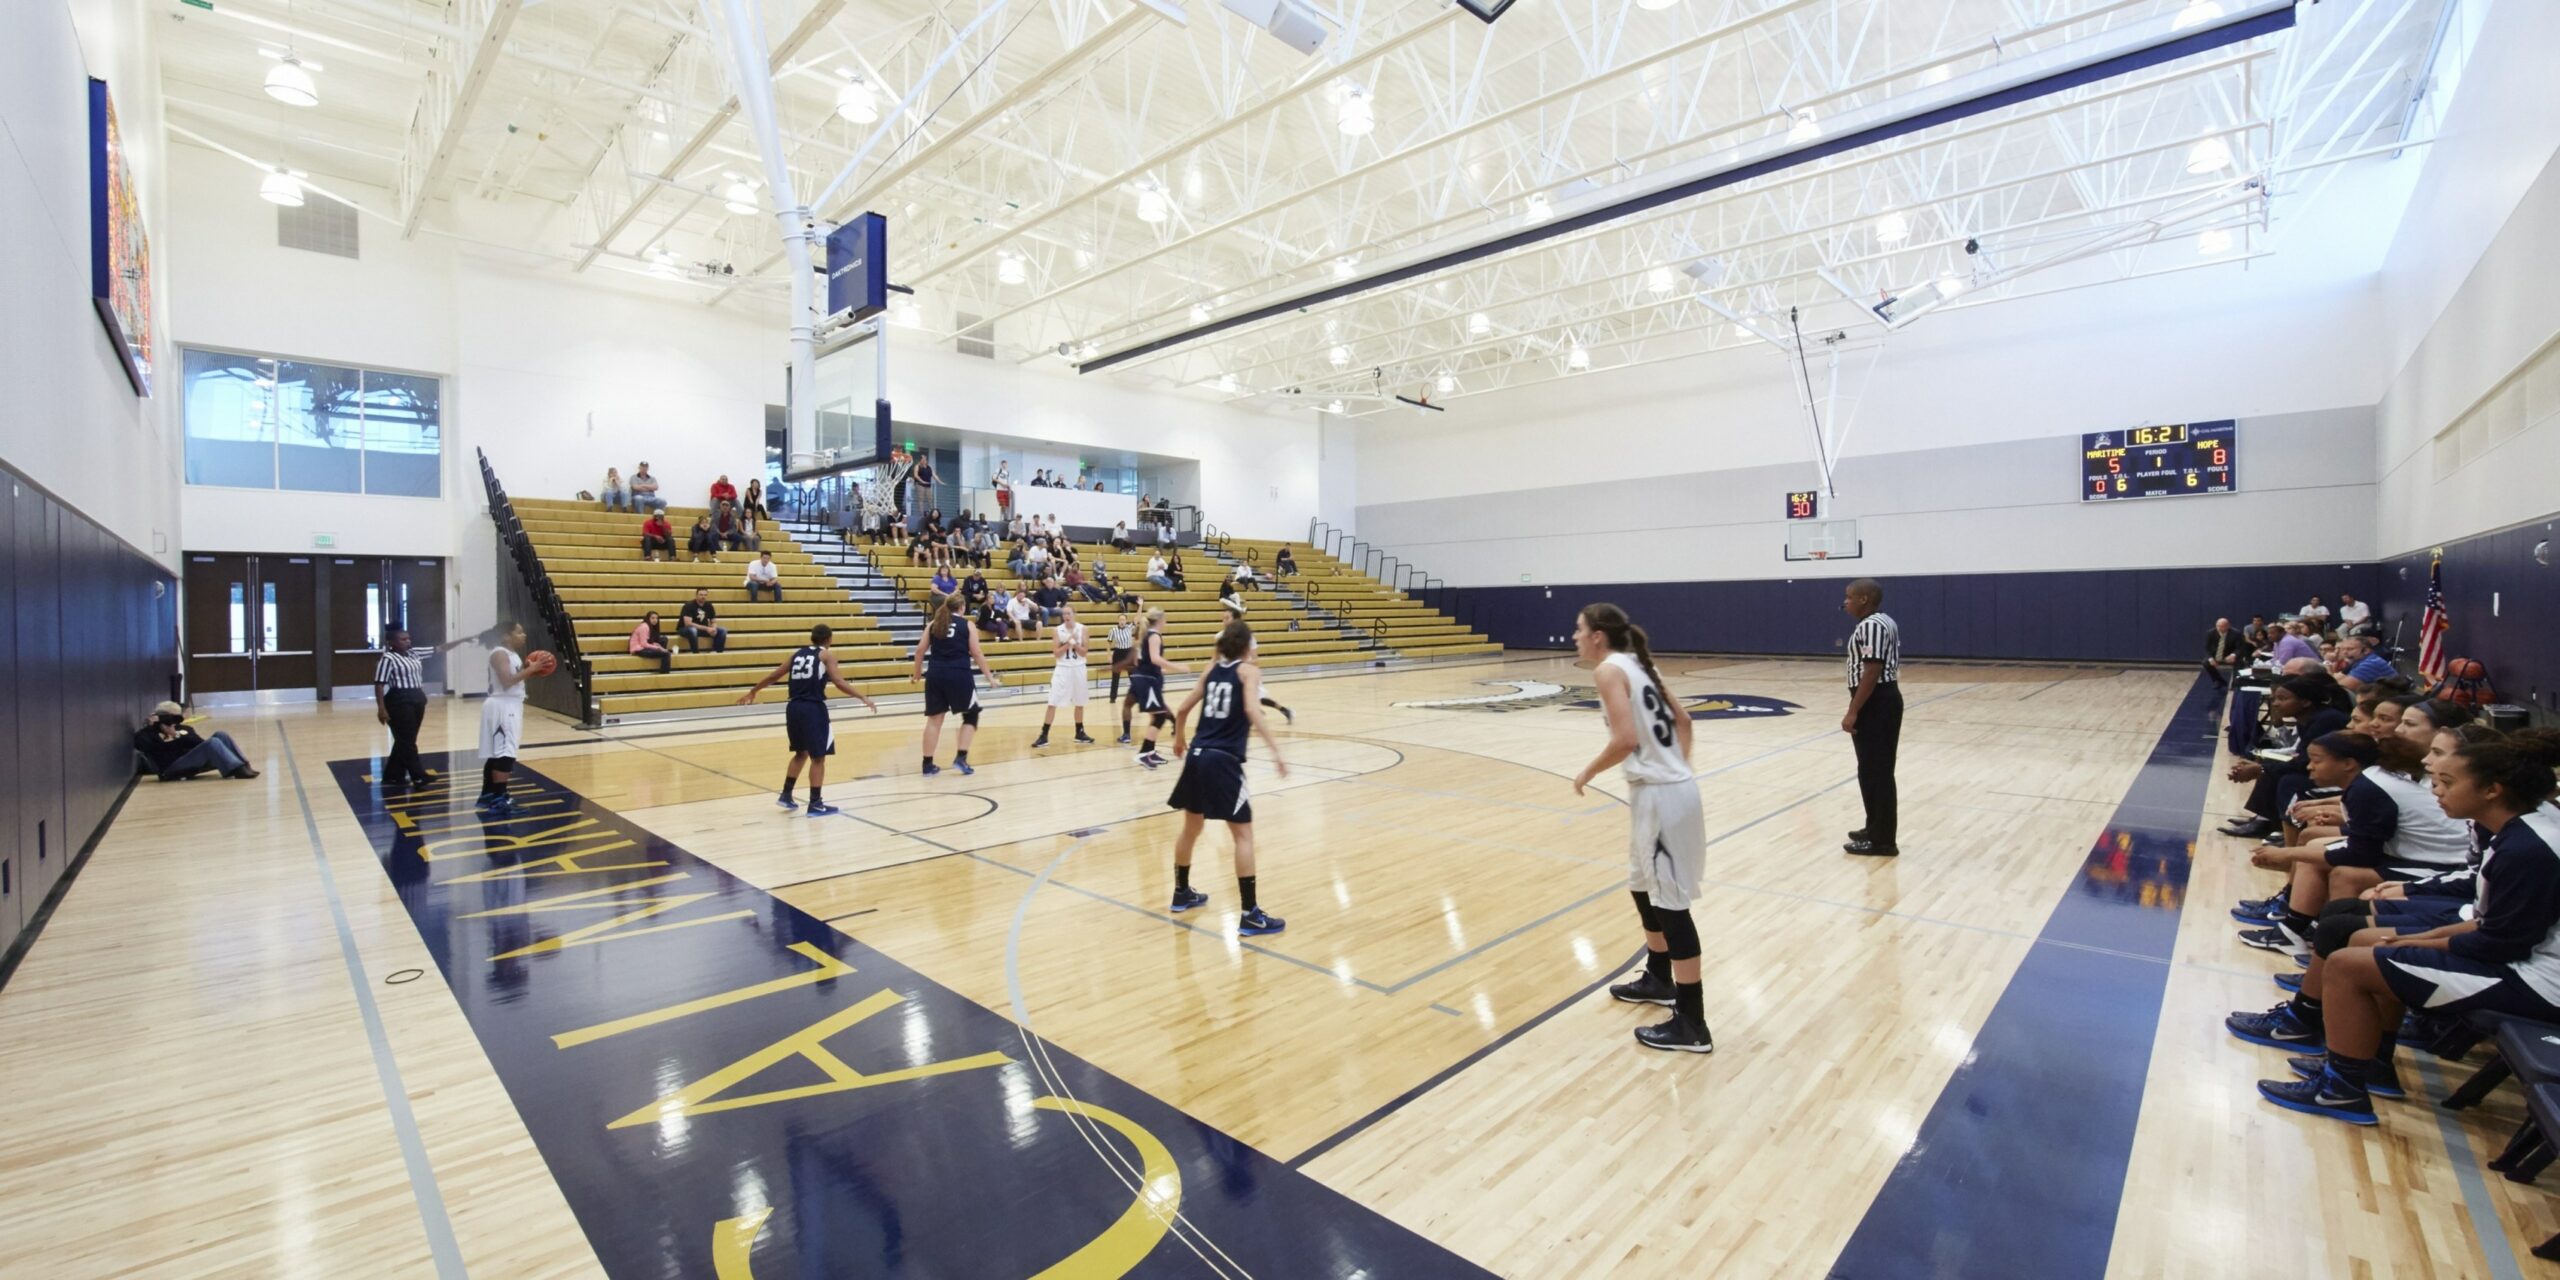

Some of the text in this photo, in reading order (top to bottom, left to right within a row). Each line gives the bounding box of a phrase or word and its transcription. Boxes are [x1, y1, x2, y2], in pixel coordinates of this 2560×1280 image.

[2135, 426, 2185, 444] 16:21
[2197, 440, 2219, 449] HOPE
[2087, 448, 2126, 459] MARITIME
[2213, 449, 2226, 465] 8
[2108, 457, 2120, 473] 5
[2156, 456, 2162, 468] 1
[2136, 470, 2160, 478] PLAYER
[2186, 473, 2198, 487] 6
[2221, 472, 2226, 483] 1
[2096, 480, 2105, 493] 0
[2116, 479, 2127, 492] 6
[1791, 493, 1814, 503] 16:21
[1792, 502, 1810, 517] 30
[791, 655, 815, 679] 23
[1204, 681, 1233, 718] 10
